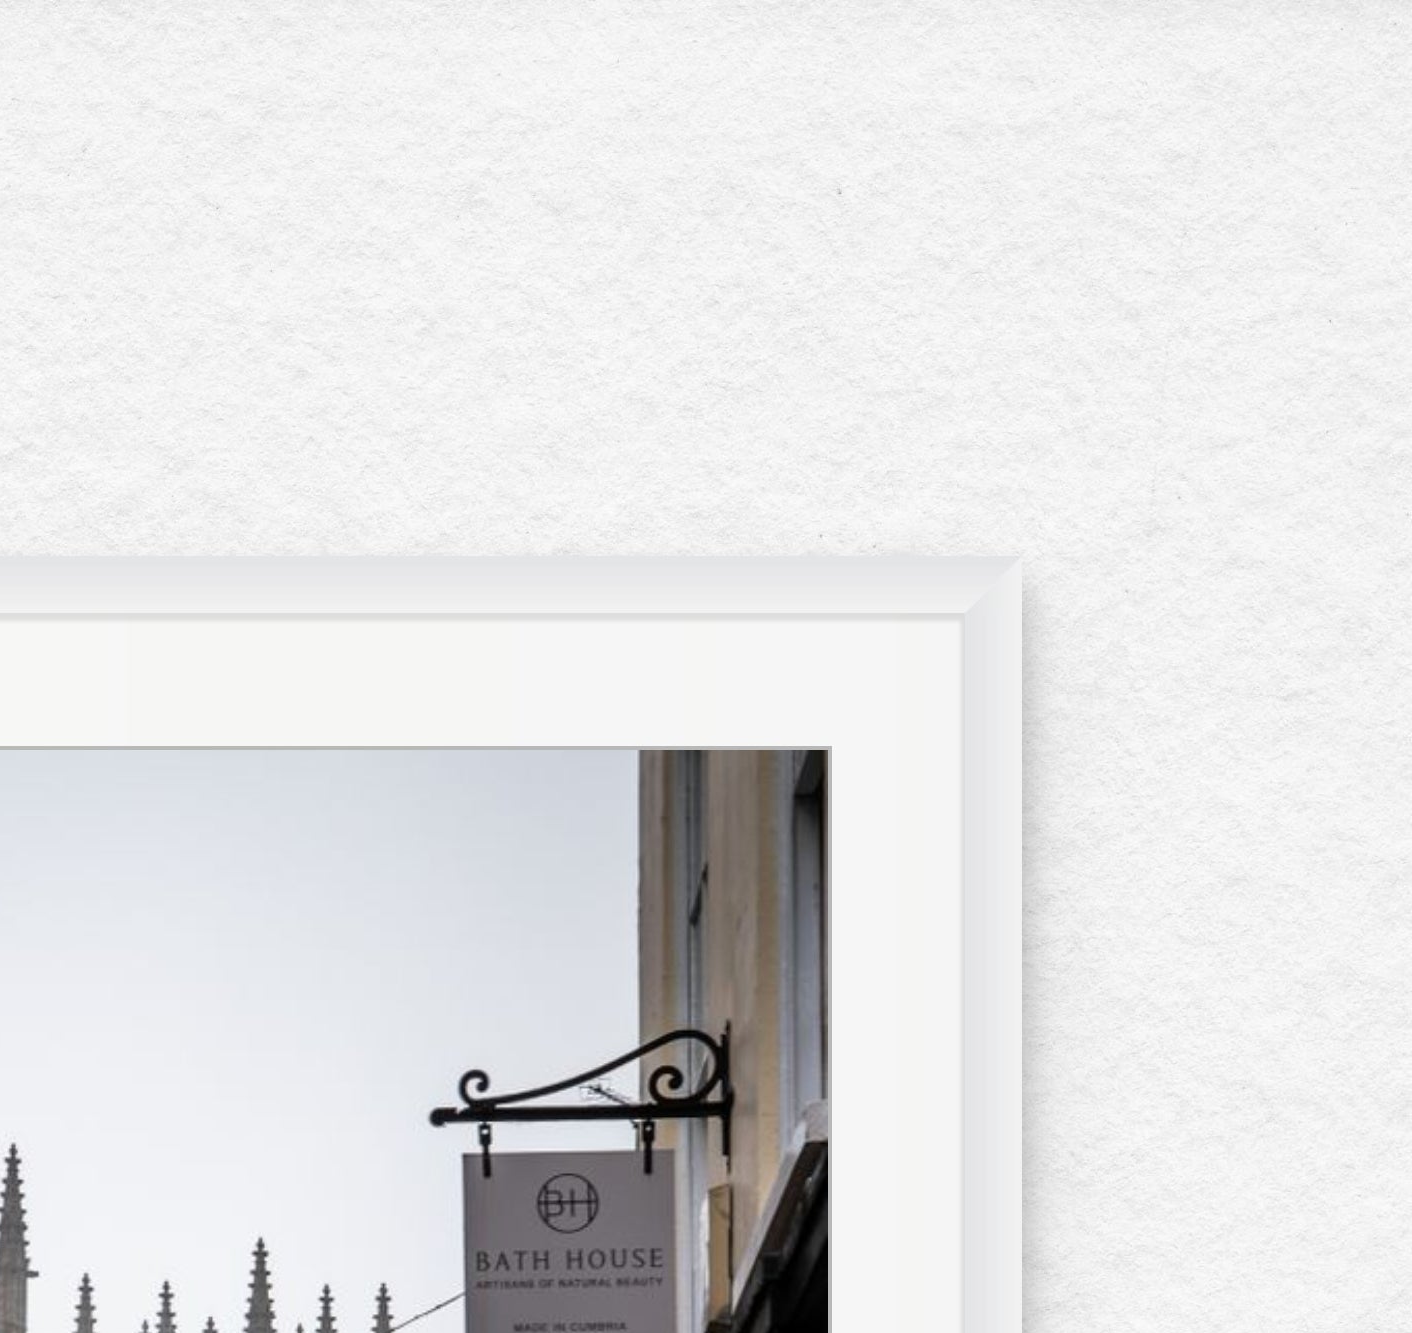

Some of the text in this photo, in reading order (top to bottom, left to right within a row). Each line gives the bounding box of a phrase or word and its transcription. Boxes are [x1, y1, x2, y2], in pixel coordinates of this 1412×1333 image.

[475, 1247, 664, 1272] BATH HOUSE
[475, 1276, 663, 1290] ARTISANS OF NATURAL BEAUTY
[513, 1320, 627, 1333] MADE IN CUMBRIA
